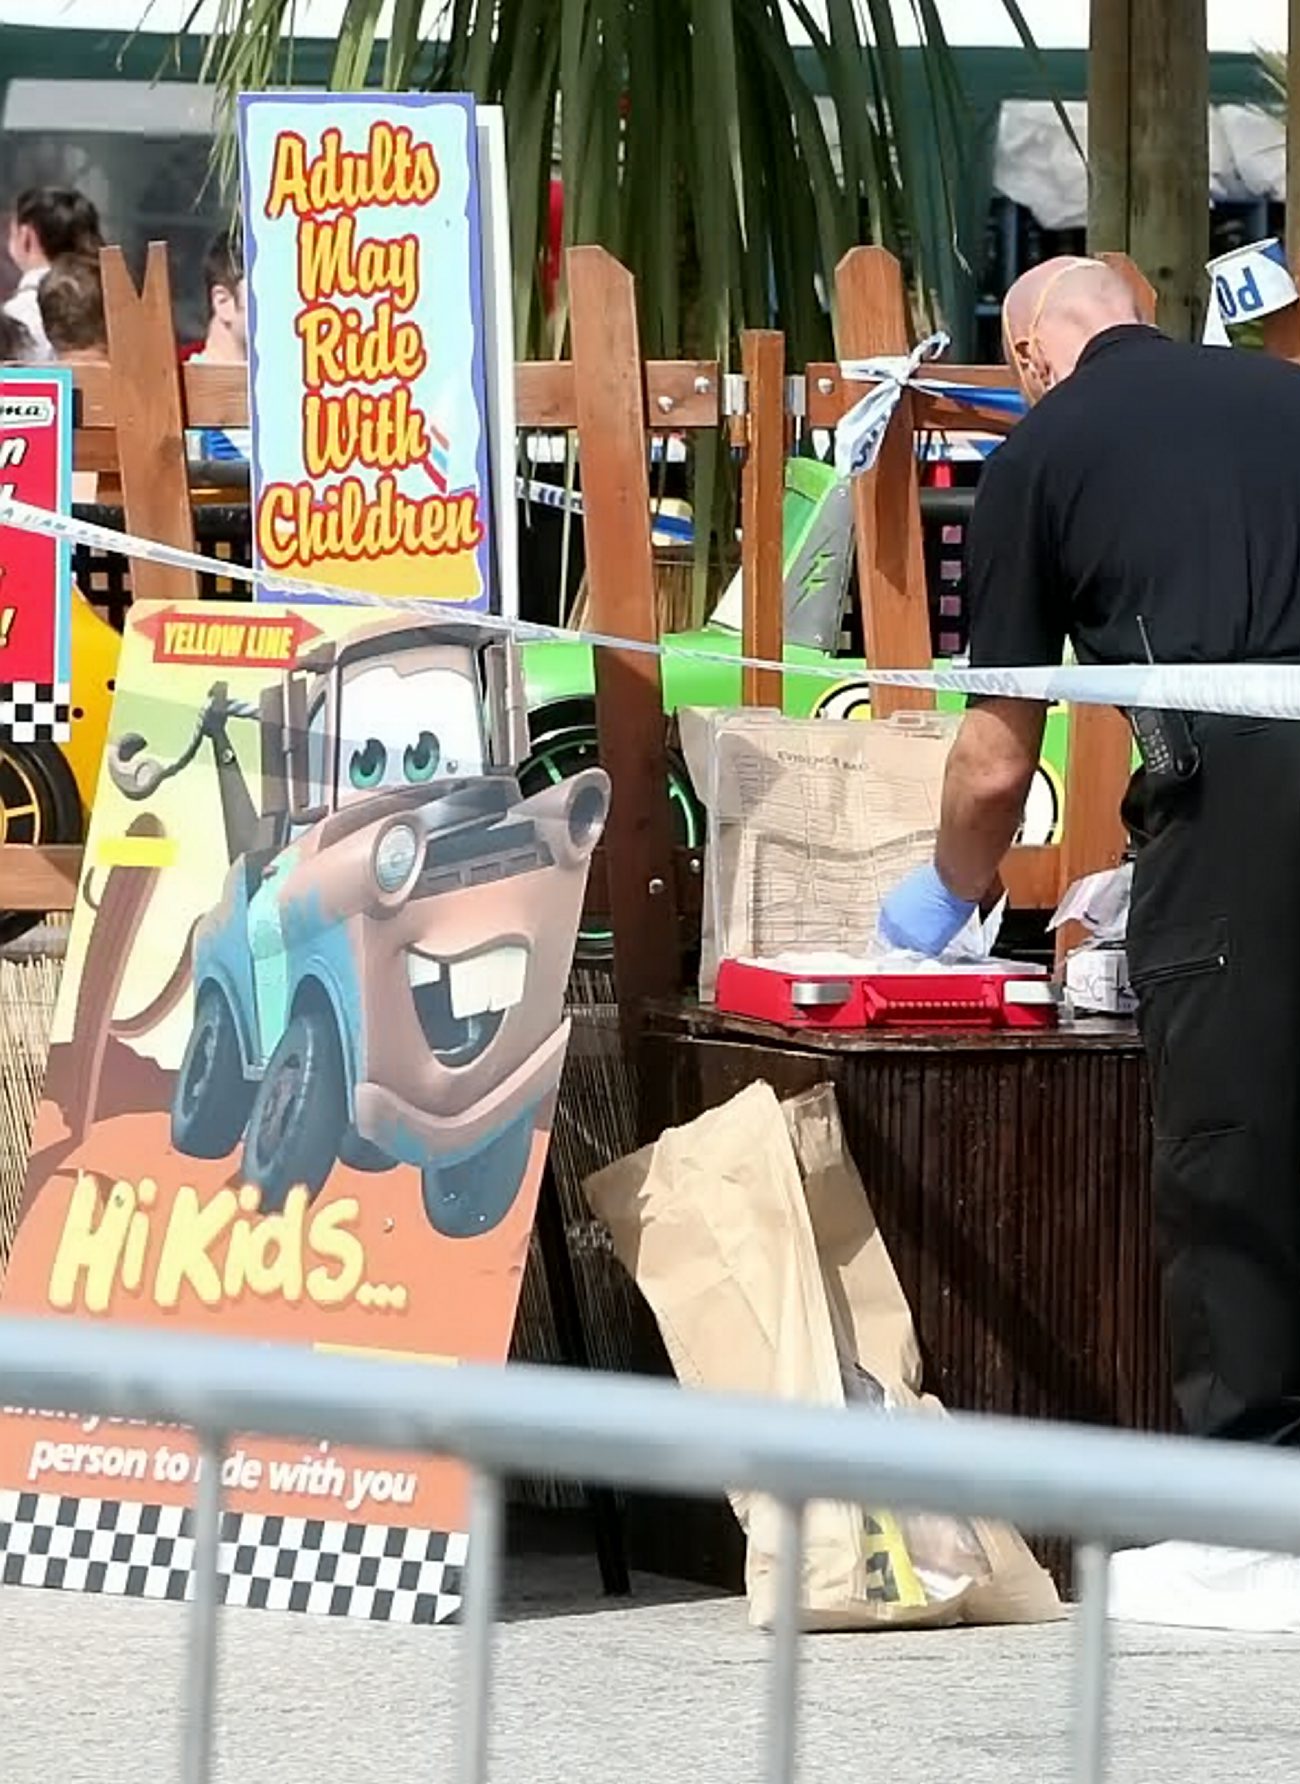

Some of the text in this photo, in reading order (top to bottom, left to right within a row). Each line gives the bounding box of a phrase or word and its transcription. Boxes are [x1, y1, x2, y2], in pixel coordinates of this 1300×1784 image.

[265, 121, 439, 219] Adults
[296, 214, 419, 308] May
[296, 306, 427, 390] Ride
[302, 383, 430, 480] With
[257, 475, 483, 569] Children
[163, 621, 294, 660] YELLOW LINE
[48, 1168, 156, 1312] Hi
[28, 1438, 147, 1481] person
[153, 1445, 191, 1483] to
[268, 1440, 347, 1498] with
[343, 1466, 417, 1512] you
